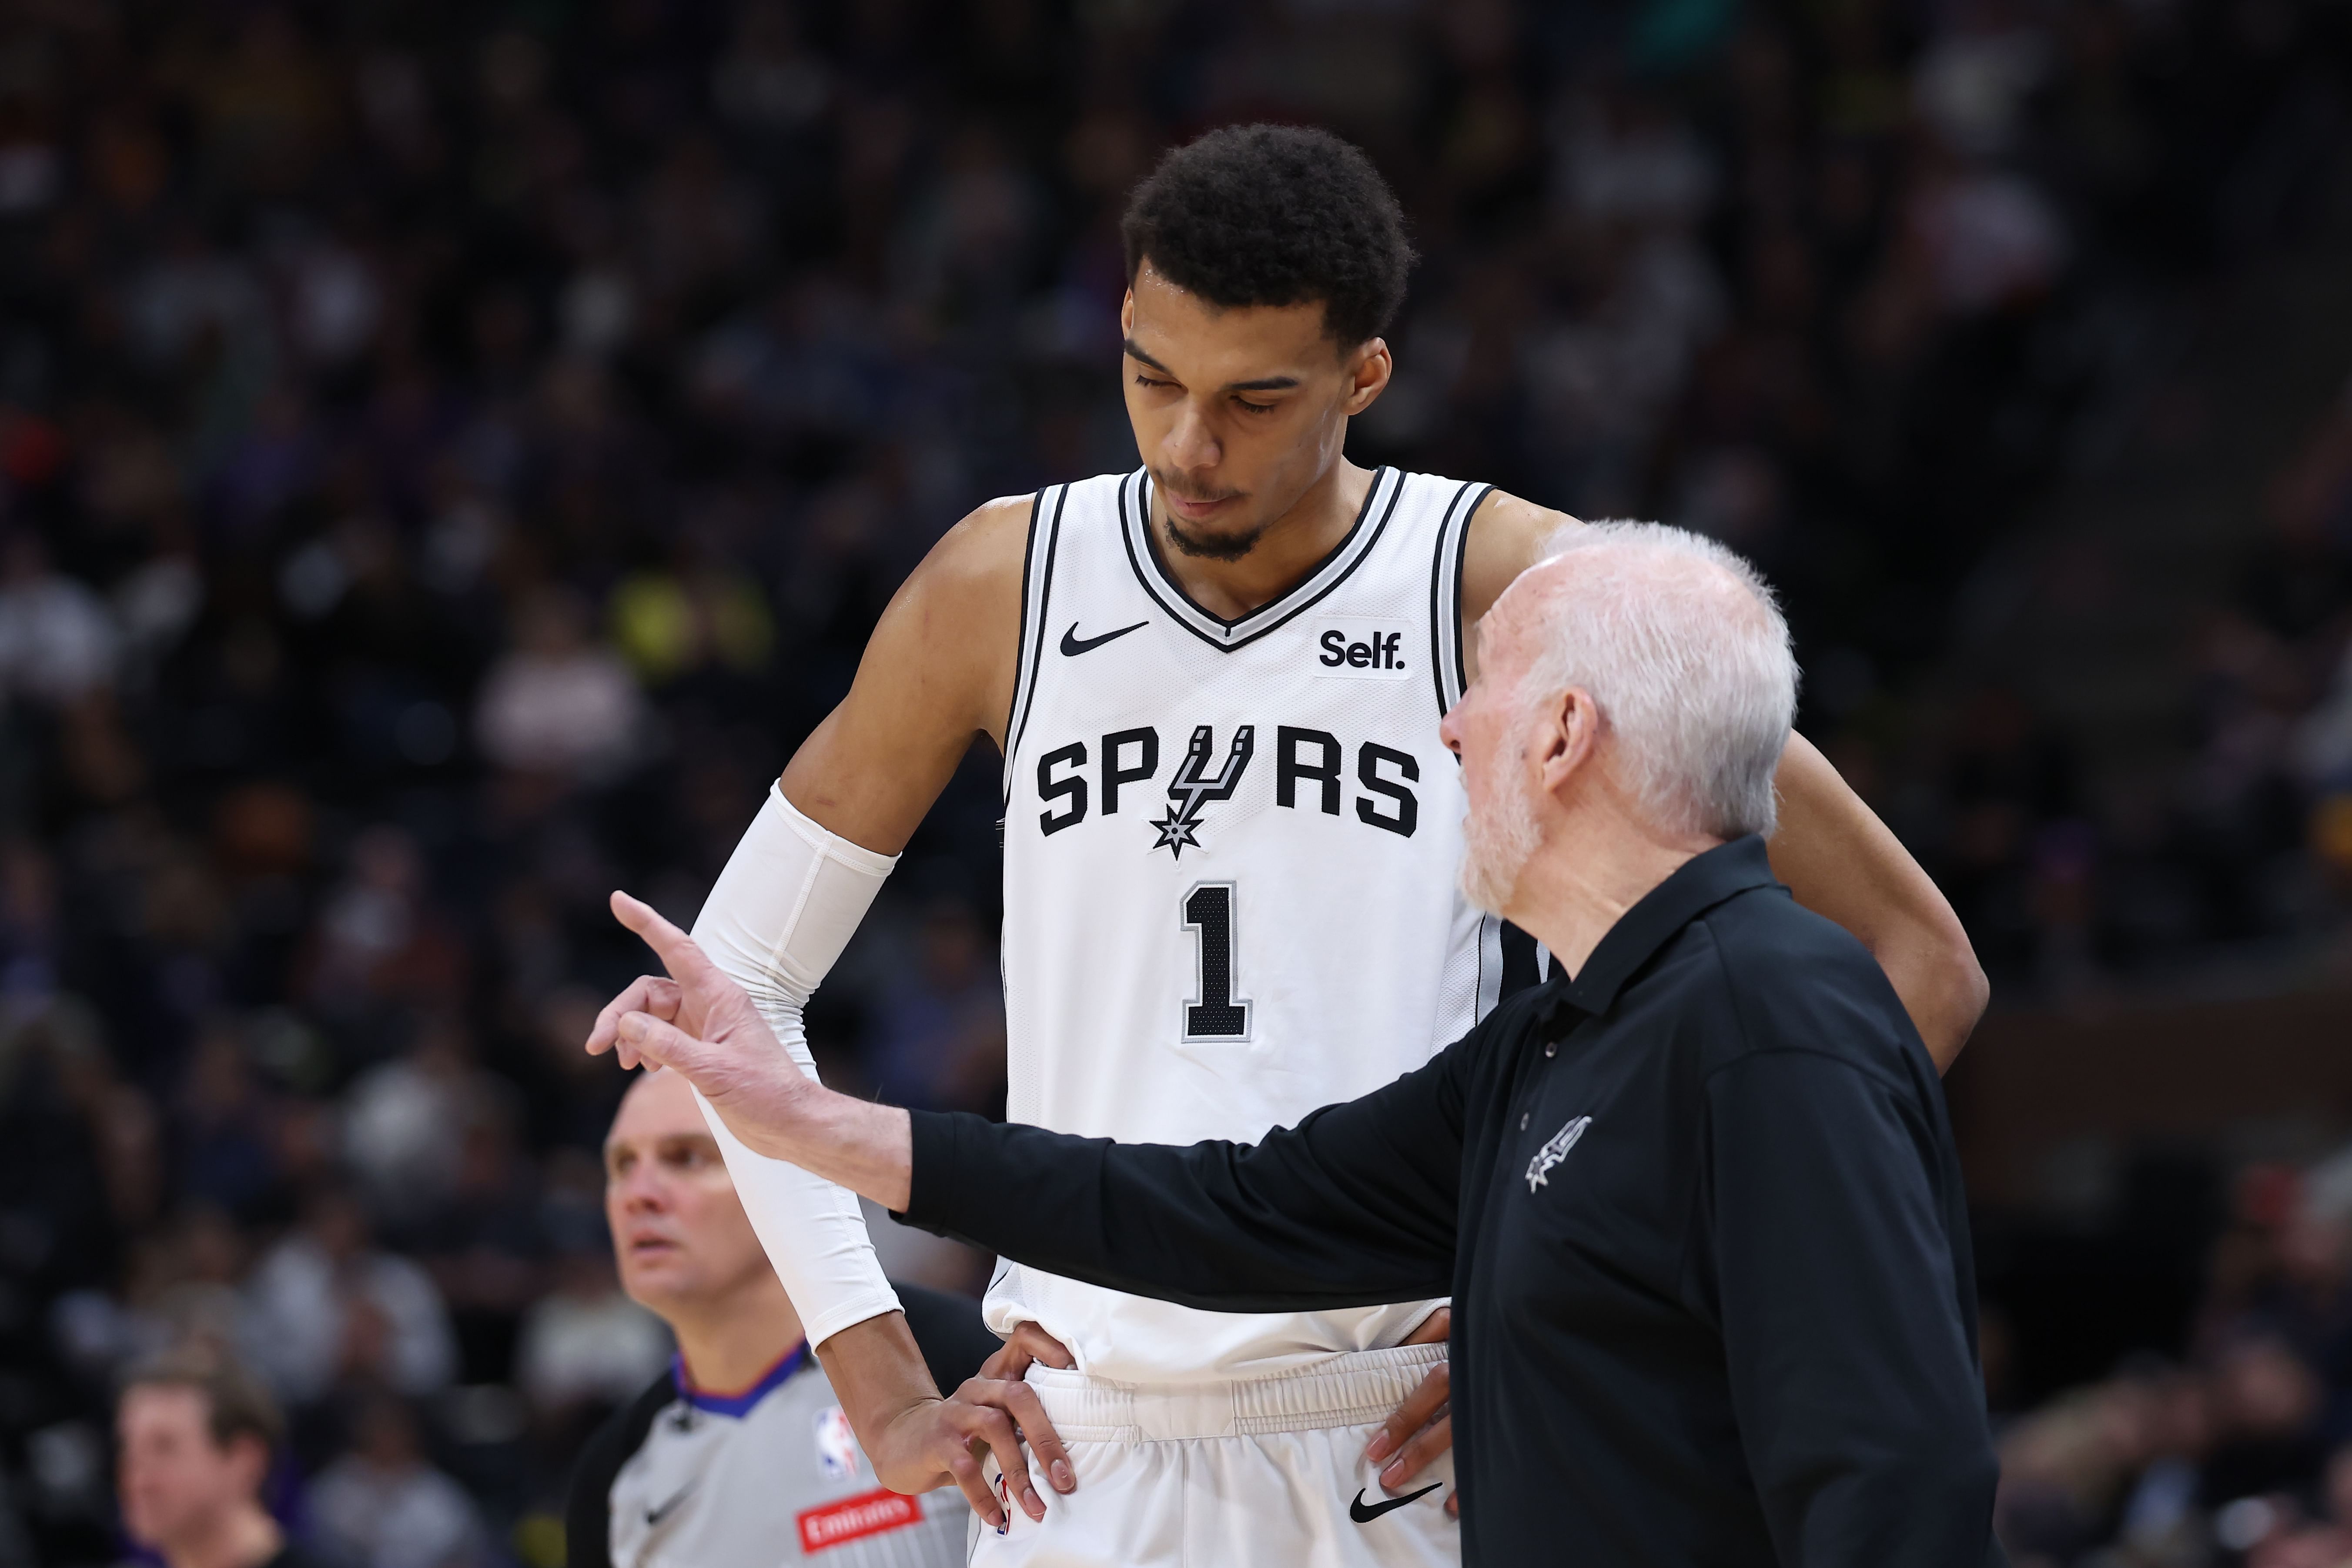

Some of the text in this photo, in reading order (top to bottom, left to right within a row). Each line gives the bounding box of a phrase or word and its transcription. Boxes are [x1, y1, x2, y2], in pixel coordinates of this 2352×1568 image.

[1319, 630, 1405, 670] Self.
[1037, 725, 1420, 861] SPURS
[1181, 881, 1251, 1043] 1
